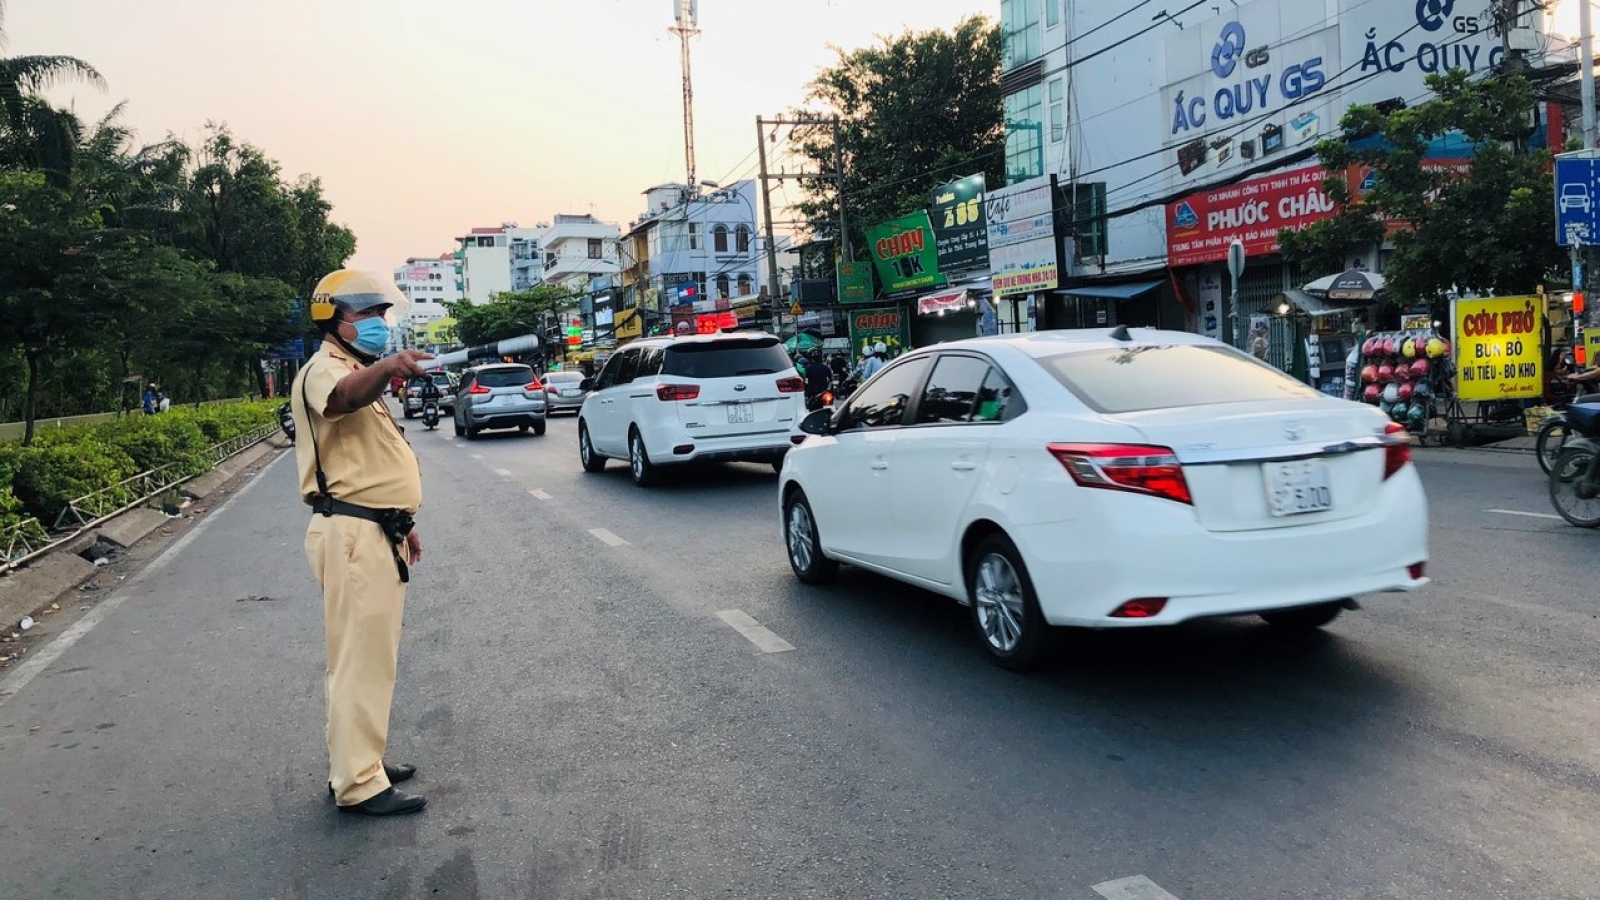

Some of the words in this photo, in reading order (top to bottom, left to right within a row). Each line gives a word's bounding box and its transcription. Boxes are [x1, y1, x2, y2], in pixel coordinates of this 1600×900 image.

[1453, 16, 1480, 33] GS
[1245, 46, 1270, 68] GS
[1361, 27, 1405, 72] ẮC
[1417, 43, 1480, 73] QUY
[1214, 74, 1271, 120] QUY
[1280, 57, 1325, 99] GS
[1242, 185, 1259, 197] CÔNG
[1260, 183, 1270, 192] TY
[1271, 179, 1288, 190] TNHH
[1288, 176, 1301, 186] TM
[1312, 170, 1328, 181] QUY
[1207, 198, 1270, 231] PHƯỚC
[1278, 187, 1335, 219] CHÂU
[876, 226, 924, 260] CHAY
[1172, 242, 1190, 253] TRUNG
[1191, 239, 1204, 249] TÂM
[1205, 236, 1222, 248] PHÂN
[1463, 308, 1498, 337] CƠM
[1501, 300, 1536, 335] PHỞ
[1475, 339, 1500, 358] BÚN
[1506, 337, 1522, 356] BÒ
[1463, 360, 1475, 381] HỦ
[1477, 361, 1496, 380] TIẾU
[1504, 360, 1516, 378] BÒ
[1518, 362, 1536, 378] KHO
